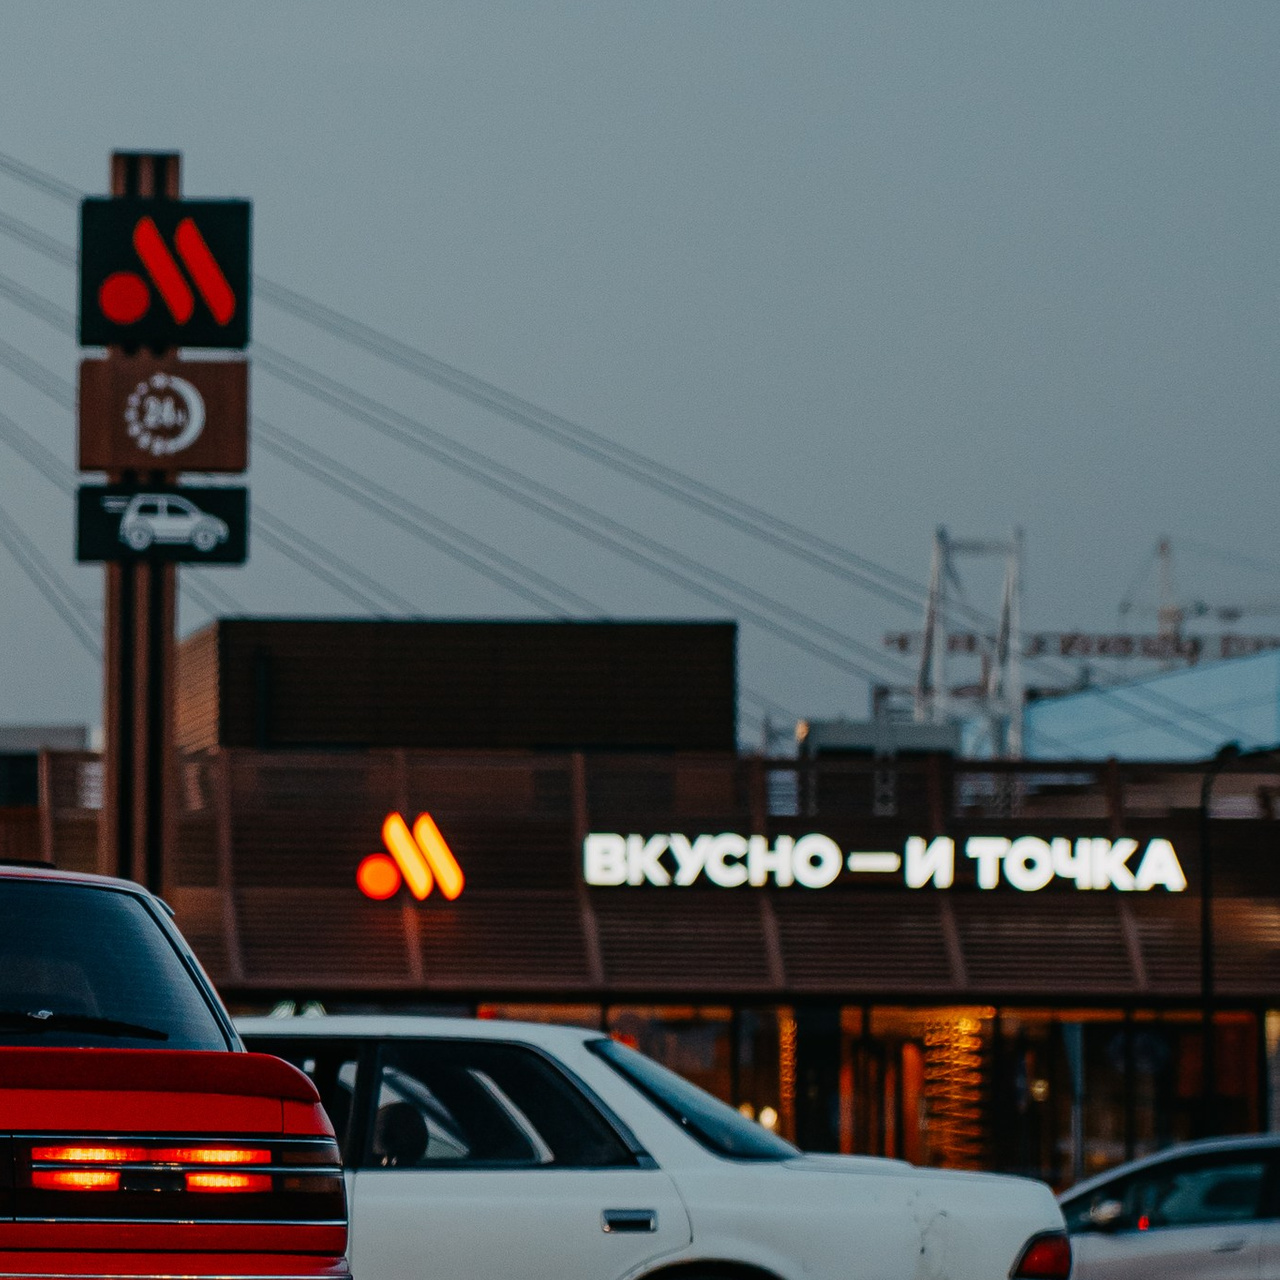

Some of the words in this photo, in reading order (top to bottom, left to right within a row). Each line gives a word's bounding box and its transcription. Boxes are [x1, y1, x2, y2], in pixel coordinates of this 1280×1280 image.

[583, 833, 843, 888] ВКУСНО
[905, 835, 955, 889] И
[966, 836, 1188, 892] ТОЧКА
